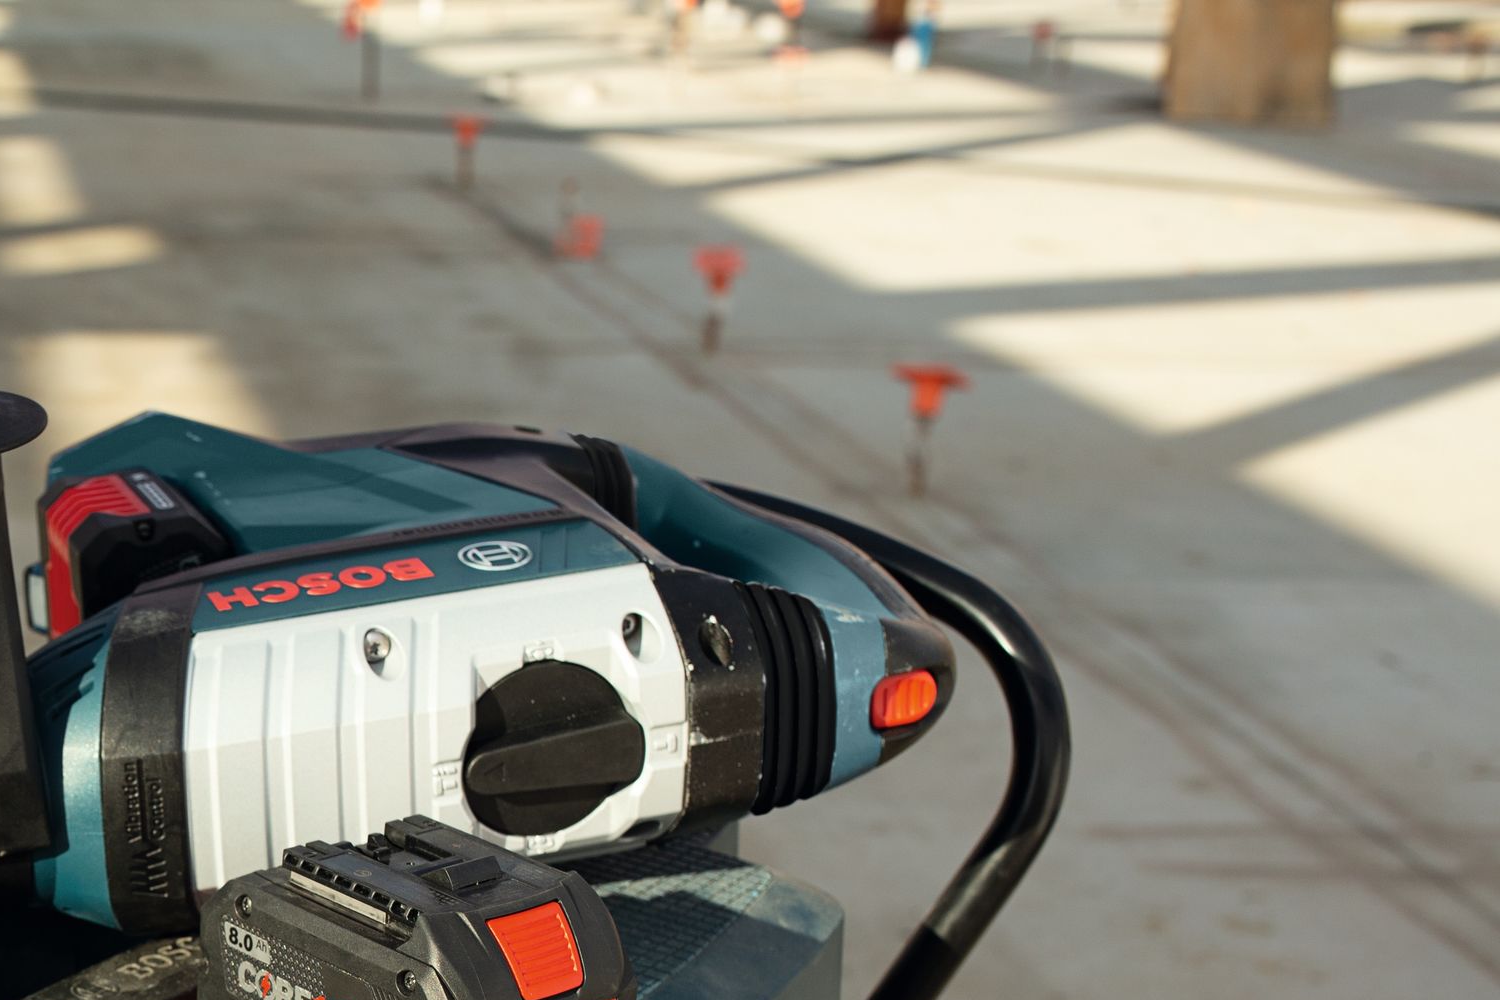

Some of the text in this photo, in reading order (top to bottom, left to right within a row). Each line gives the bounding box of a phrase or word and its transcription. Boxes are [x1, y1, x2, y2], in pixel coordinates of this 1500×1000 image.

[206, 556, 436, 612] BOSCH
[121, 762, 143, 844] Vibration
[145, 776, 166, 841] Control
[116, 936, 201, 979] BOSC
[228, 926, 268, 953] 8.0 Ah
